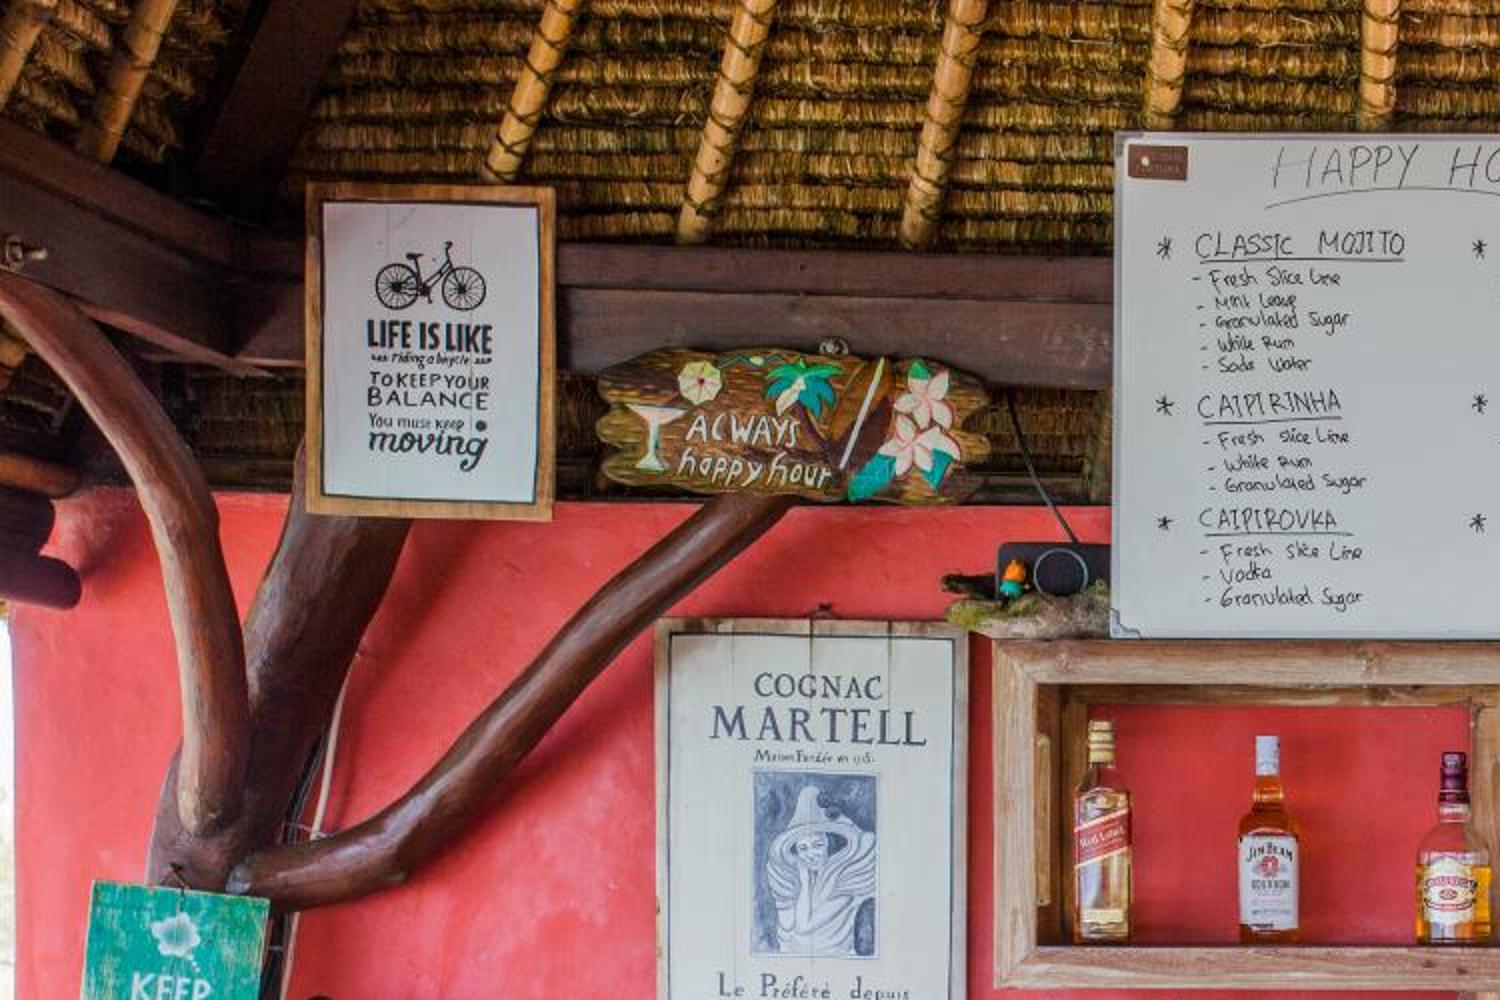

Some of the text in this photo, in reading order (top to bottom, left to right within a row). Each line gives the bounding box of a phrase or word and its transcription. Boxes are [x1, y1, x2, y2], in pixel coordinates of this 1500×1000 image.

[1272, 143, 1421, 190] HAPPY
[1196, 230, 1405, 258] CLASSIC MOJITO
[1208, 268, 1257, 293] Fresh
[1308, 312, 1351, 336] Sugar
[367, 319, 493, 355] LIFE IS LIKE
[1261, 336, 1295, 350] Rum
[396, 373, 441, 388] KEEP
[444, 374, 489, 390] YOUR
[368, 386, 489, 410] BALANCE
[1197, 388, 1341, 419] CAIPIRINHA
[1218, 429, 1264, 450] Fresh
[677, 446, 832, 488] happy hour
[1322, 473, 1367, 495] Sugar
[1199, 507, 1337, 531] CAIPIROVKA
[1220, 542, 1273, 565] Fresh
[1220, 561, 1272, 584] Vodka
[753, 671, 884, 701] COGNAC
[710, 704, 927, 746] MARTELL
[718, 972, 745, 998] Le
